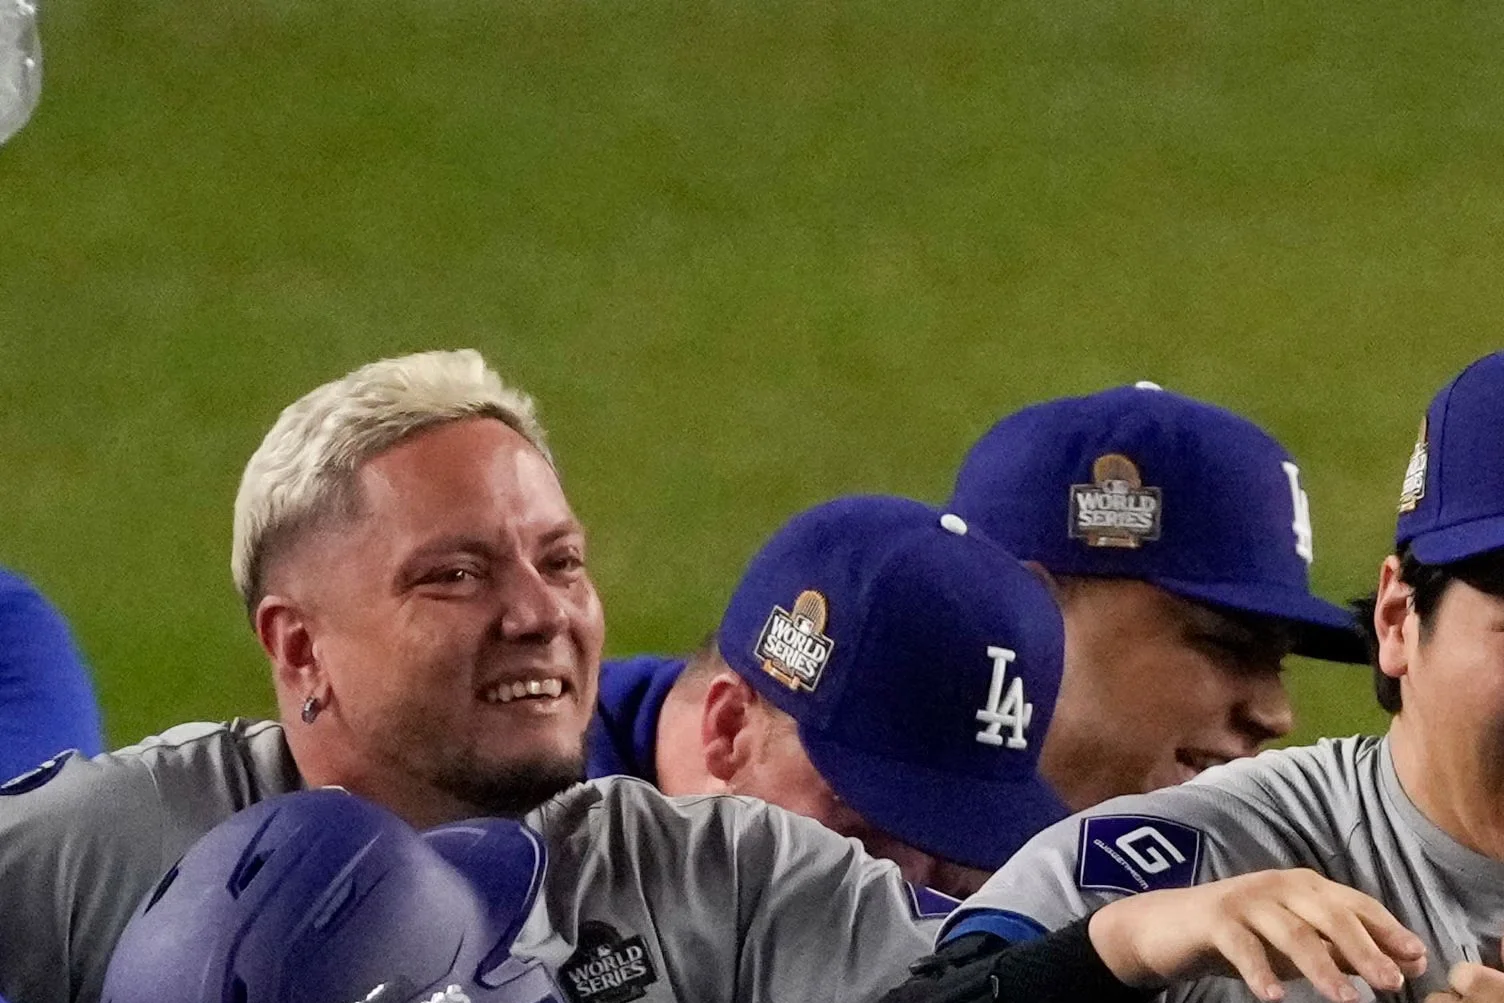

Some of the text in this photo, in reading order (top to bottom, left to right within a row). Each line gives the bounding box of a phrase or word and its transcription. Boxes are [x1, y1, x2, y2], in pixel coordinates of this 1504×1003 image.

[1076, 493, 1157, 513] WORLD
[1078, 510, 1153, 528] SERIES
[764, 633, 818, 678] SERIES
[771, 614, 826, 663] WORLD
[976, 646, 1033, 749] LA
[568, 945, 643, 984] WORLD
[576, 960, 647, 997] SERIES
